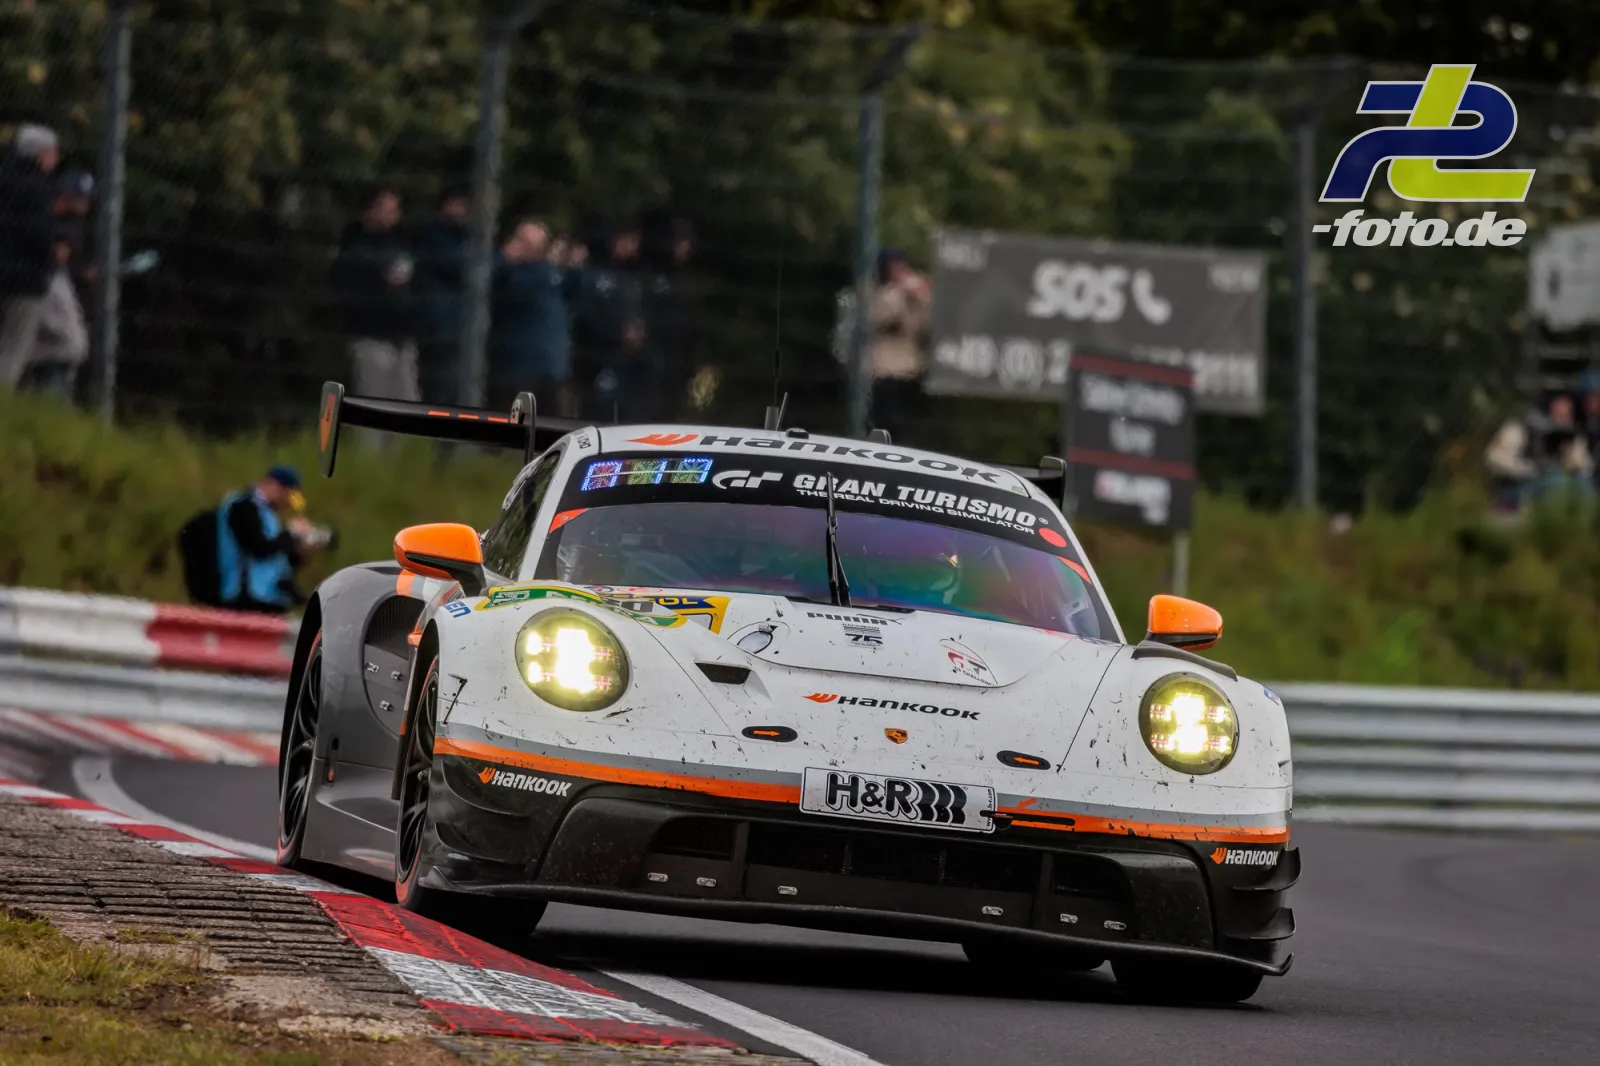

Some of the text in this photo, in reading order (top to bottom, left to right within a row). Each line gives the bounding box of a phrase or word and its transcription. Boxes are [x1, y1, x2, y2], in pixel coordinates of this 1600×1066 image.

[1026, 259, 1130, 322] SOS
[792, 474, 887, 497] GRAN
[796, 489, 1036, 535] THE REAL DRIVING SIMULATOR
